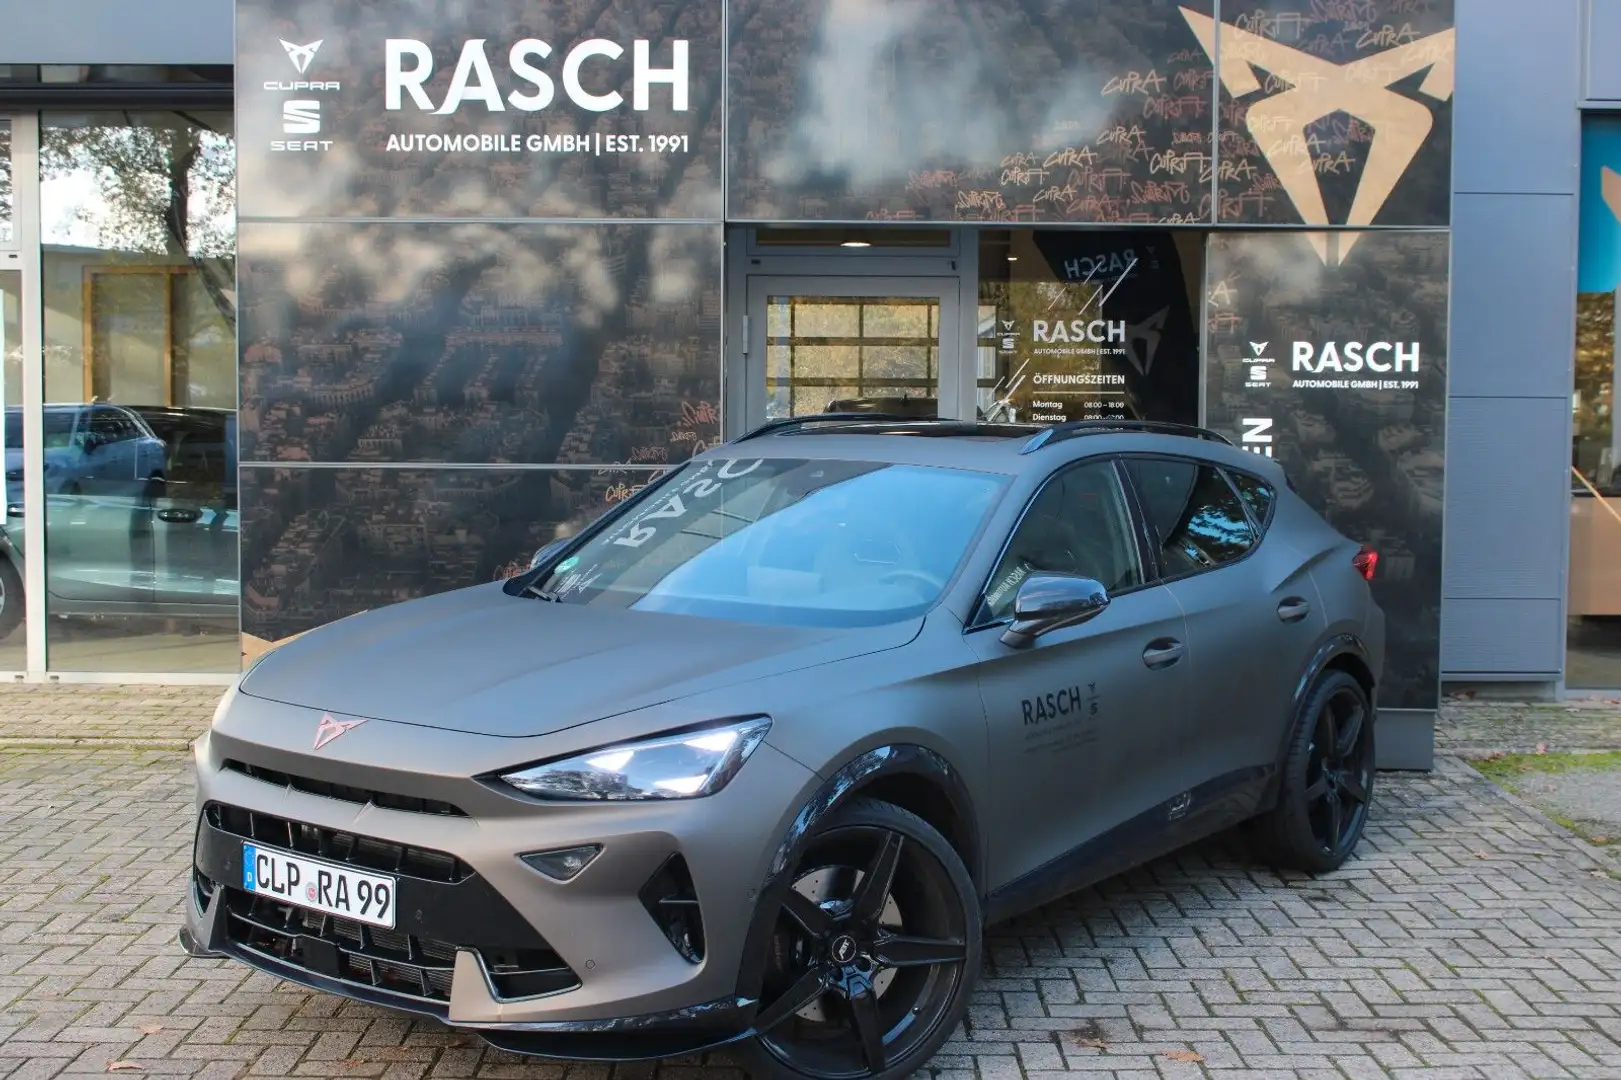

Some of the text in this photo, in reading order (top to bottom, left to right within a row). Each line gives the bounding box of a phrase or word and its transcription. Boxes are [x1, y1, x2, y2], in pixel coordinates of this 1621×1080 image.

[385, 38, 689, 115] RASCH
[263, 81, 340, 91] CUPRA
[271, 140, 333, 151] SEAT
[386, 134, 521, 153] AUTOMOBILE
[527, 134, 590, 153] GMBH
[605, 134, 644, 153] EST.
[649, 134, 689, 153] 1991
[1033, 320, 1126, 343] RASCH
[1292, 341, 1420, 373] RASCH
[1033, 372, 1125, 385] ÖFFNUNGSZEITEN
[1292, 380, 1350, 388] AUTOMOBILE
[1350, 380, 1378, 388] GMBH
[1383, 380, 1400, 388] EST.
[1033, 401, 1063, 410] Montag
[1033, 413, 1067, 422] Dienstag
[1022, 686, 1081, 725] RASCH
[256, 854, 391, 919] CLP RA 99
